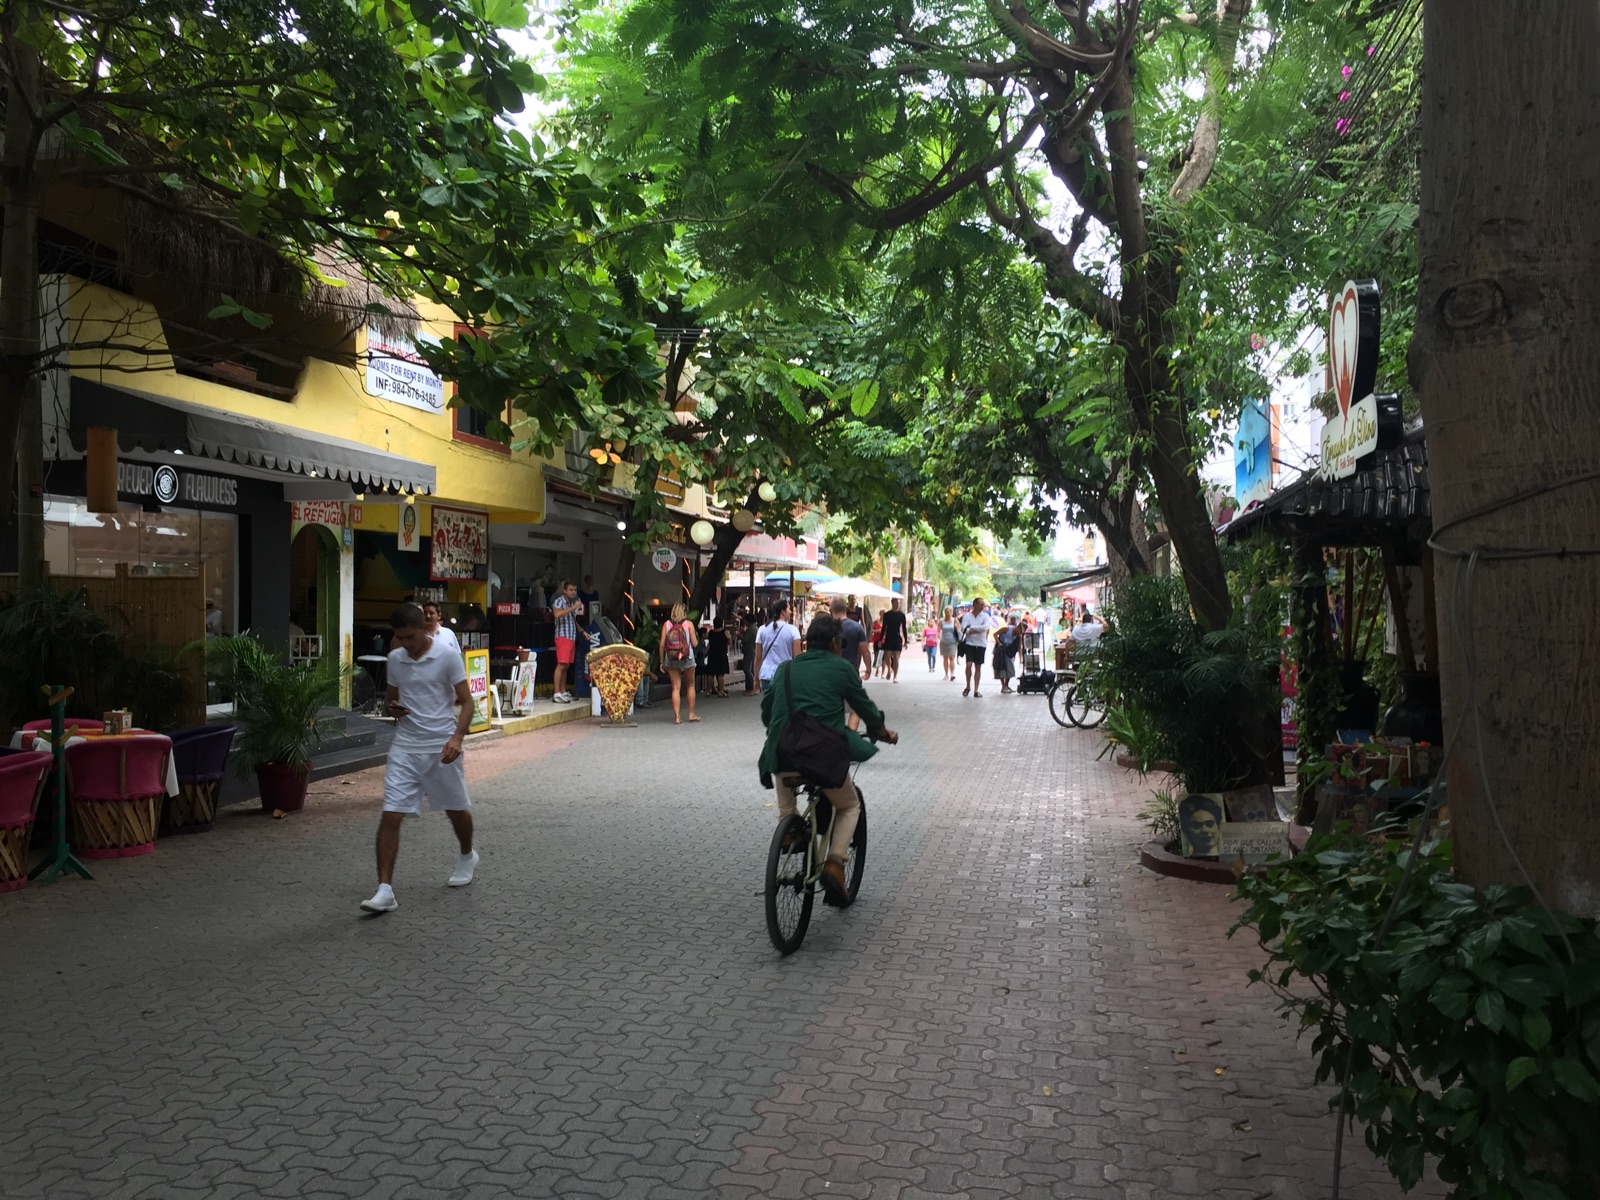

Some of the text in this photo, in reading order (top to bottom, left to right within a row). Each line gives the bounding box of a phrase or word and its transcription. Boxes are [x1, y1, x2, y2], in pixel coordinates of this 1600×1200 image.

[375, 376, 391, 392] INF:
[391, 364, 402, 377] FOR
[403, 367, 417, 382] RENT
[417, 372, 425, 384] BY
[425, 375, 443, 390] MONTH
[117, 462, 238, 505] REVER FLAWLESS
[293, 506, 346, 525] EL REFUGIO
[660, 561, 669, 569] 20
[470, 676, 485, 693] 2X50
[1256, 838, 1282, 846] CALLAR
